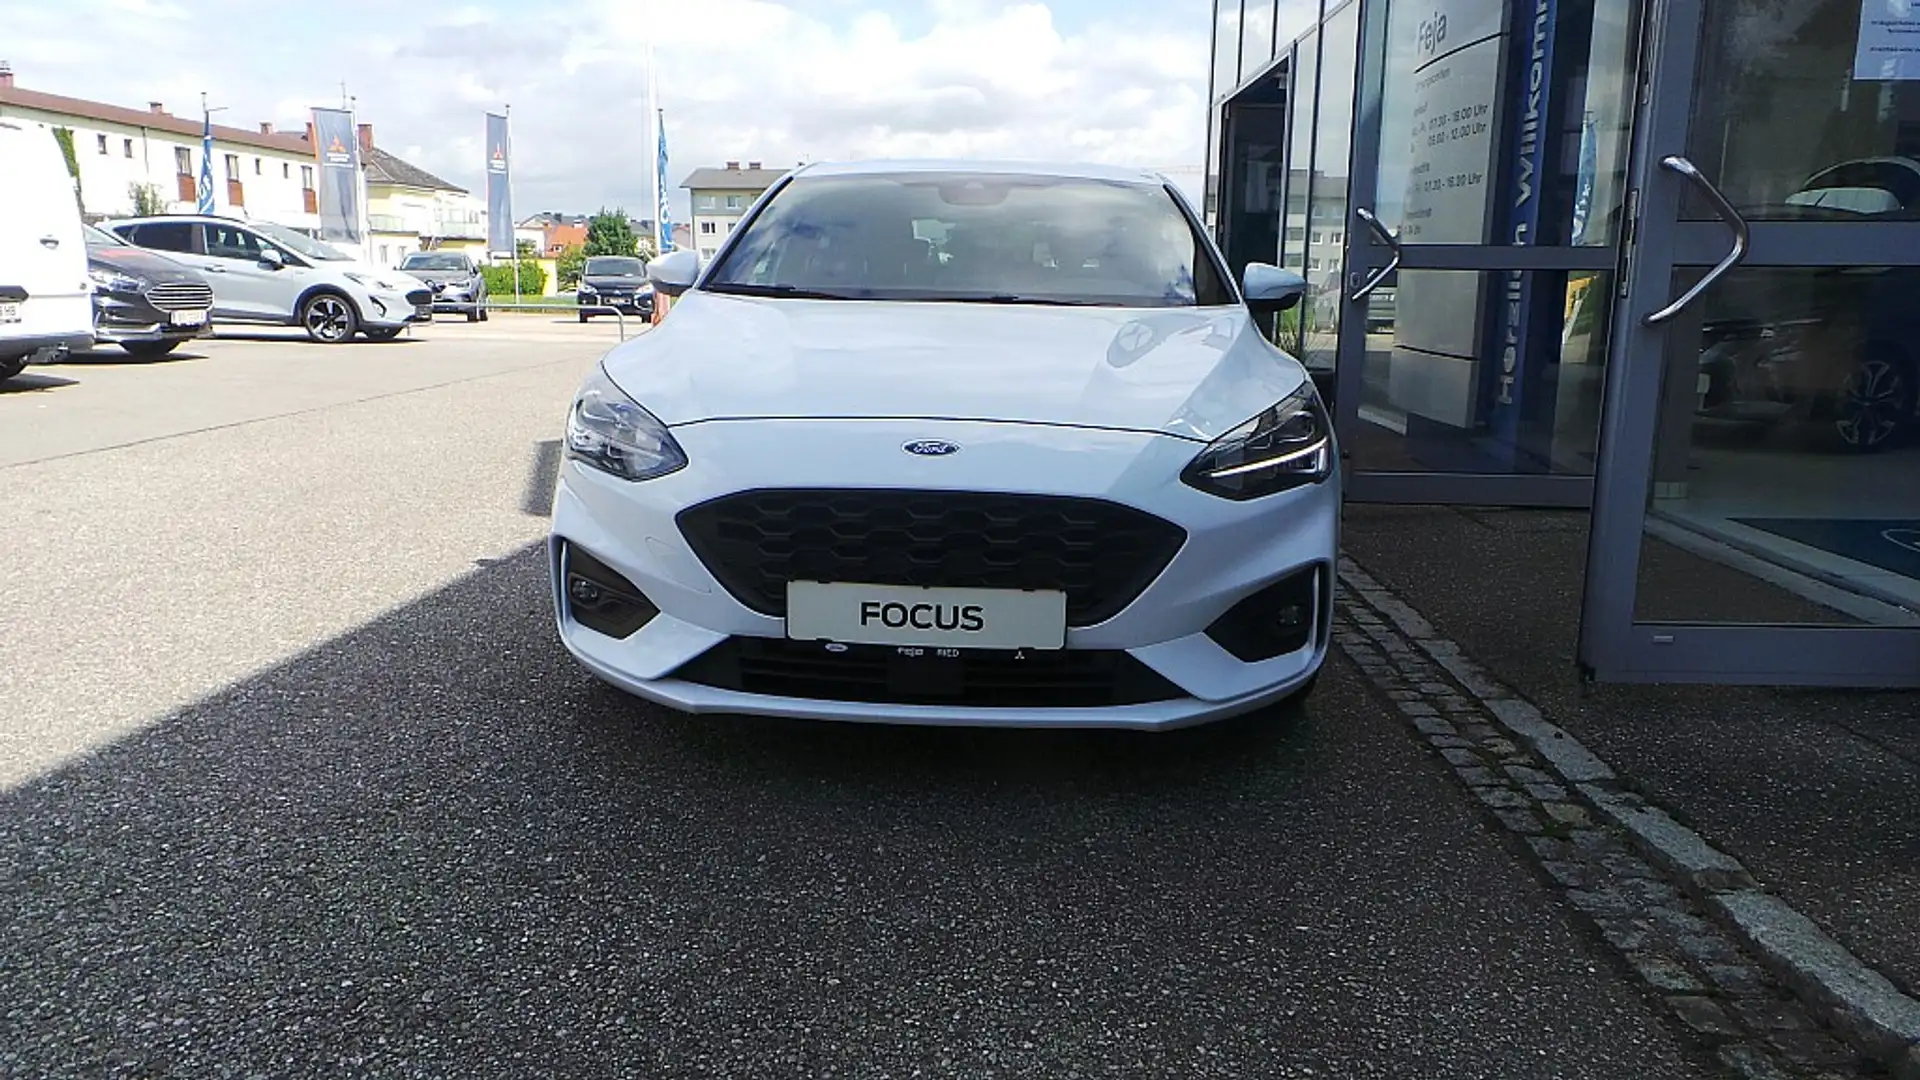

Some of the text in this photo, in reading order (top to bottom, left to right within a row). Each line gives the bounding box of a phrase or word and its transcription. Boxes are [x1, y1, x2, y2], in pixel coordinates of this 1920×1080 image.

[1418, 11, 1447, 55] Feja
[1515, 0, 1549, 208] Willkom
[860, 602, 984, 631] FOCUS
